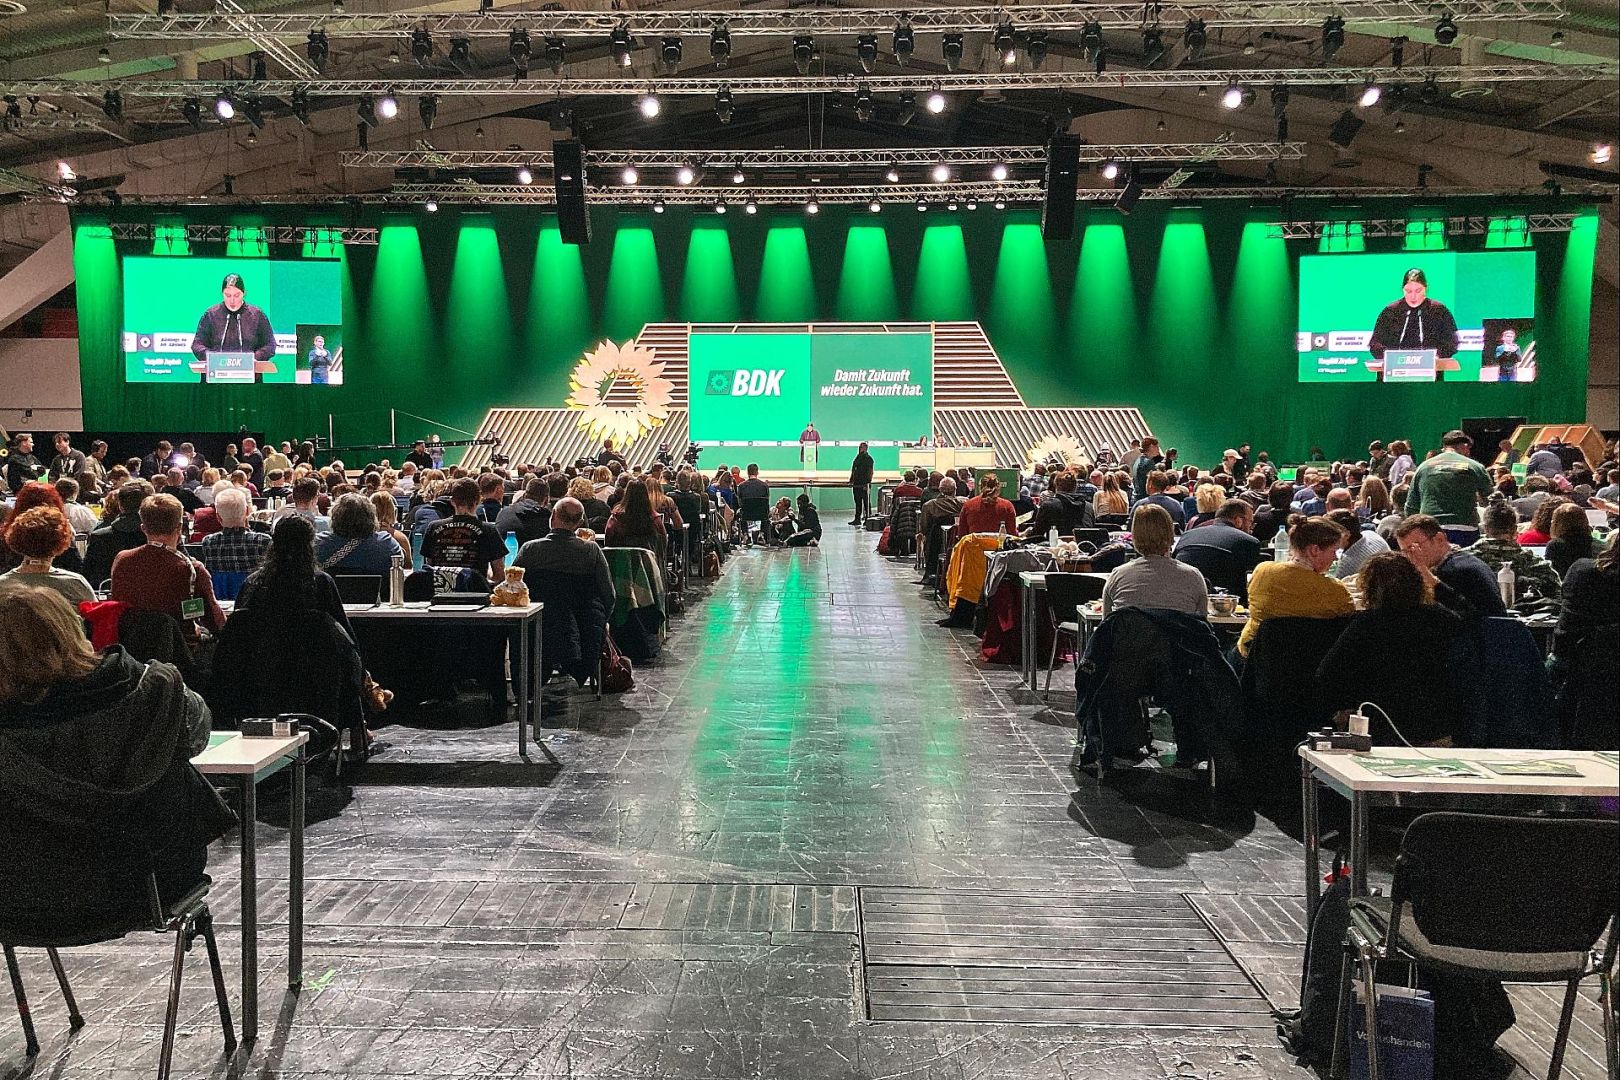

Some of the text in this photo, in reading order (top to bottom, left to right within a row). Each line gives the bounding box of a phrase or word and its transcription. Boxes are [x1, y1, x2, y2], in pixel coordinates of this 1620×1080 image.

[834, 369, 911, 382] Damit Zukunft
[731, 369, 786, 397] BDK
[820, 384, 924, 397] wieder Zukunft hat.
